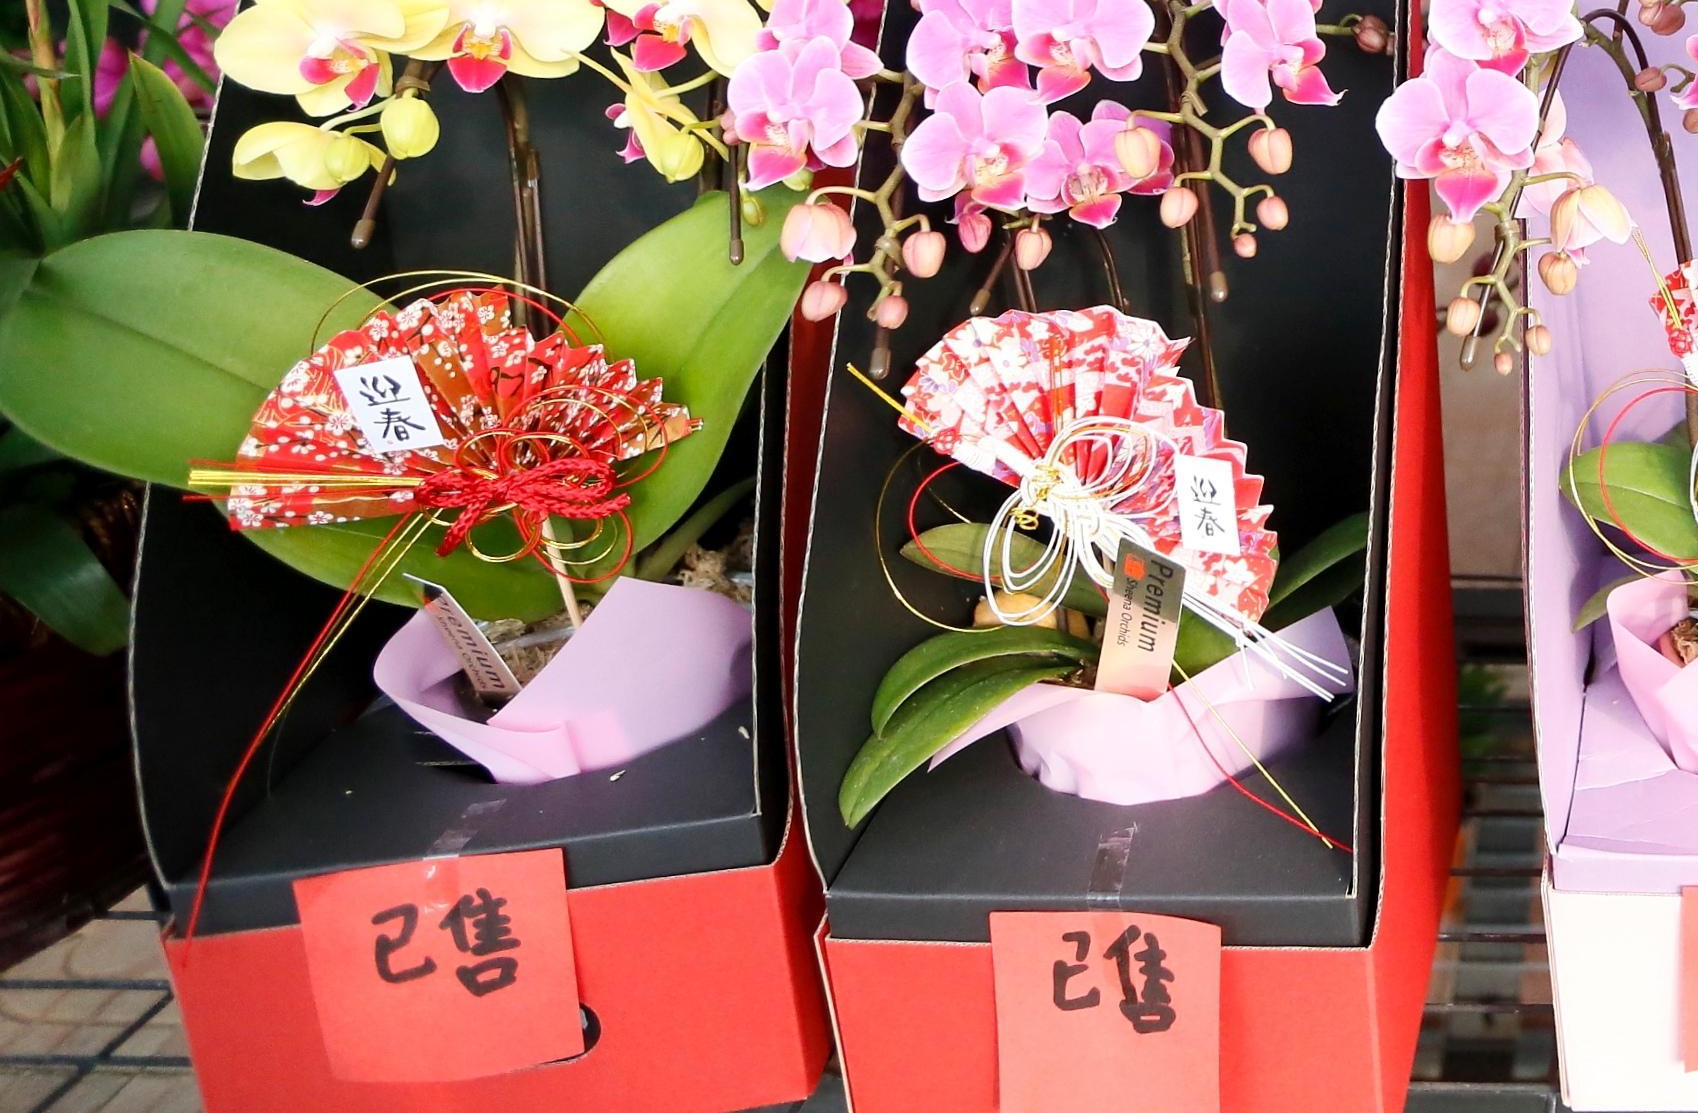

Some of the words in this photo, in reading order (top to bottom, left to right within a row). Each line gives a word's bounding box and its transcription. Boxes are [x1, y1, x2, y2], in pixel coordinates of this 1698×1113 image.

[359, 374, 427, 441] 迎春
[1190, 475, 1225, 536] 迎春
[1117, 612, 1133, 647] Orchids
[1122, 577, 1138, 611] Sheena
[1137, 559, 1174, 652] Premium
[438, 595, 505, 689] Premium
[371, 888, 522, 997] 已售
[1053, 925, 1177, 1034] 已售
